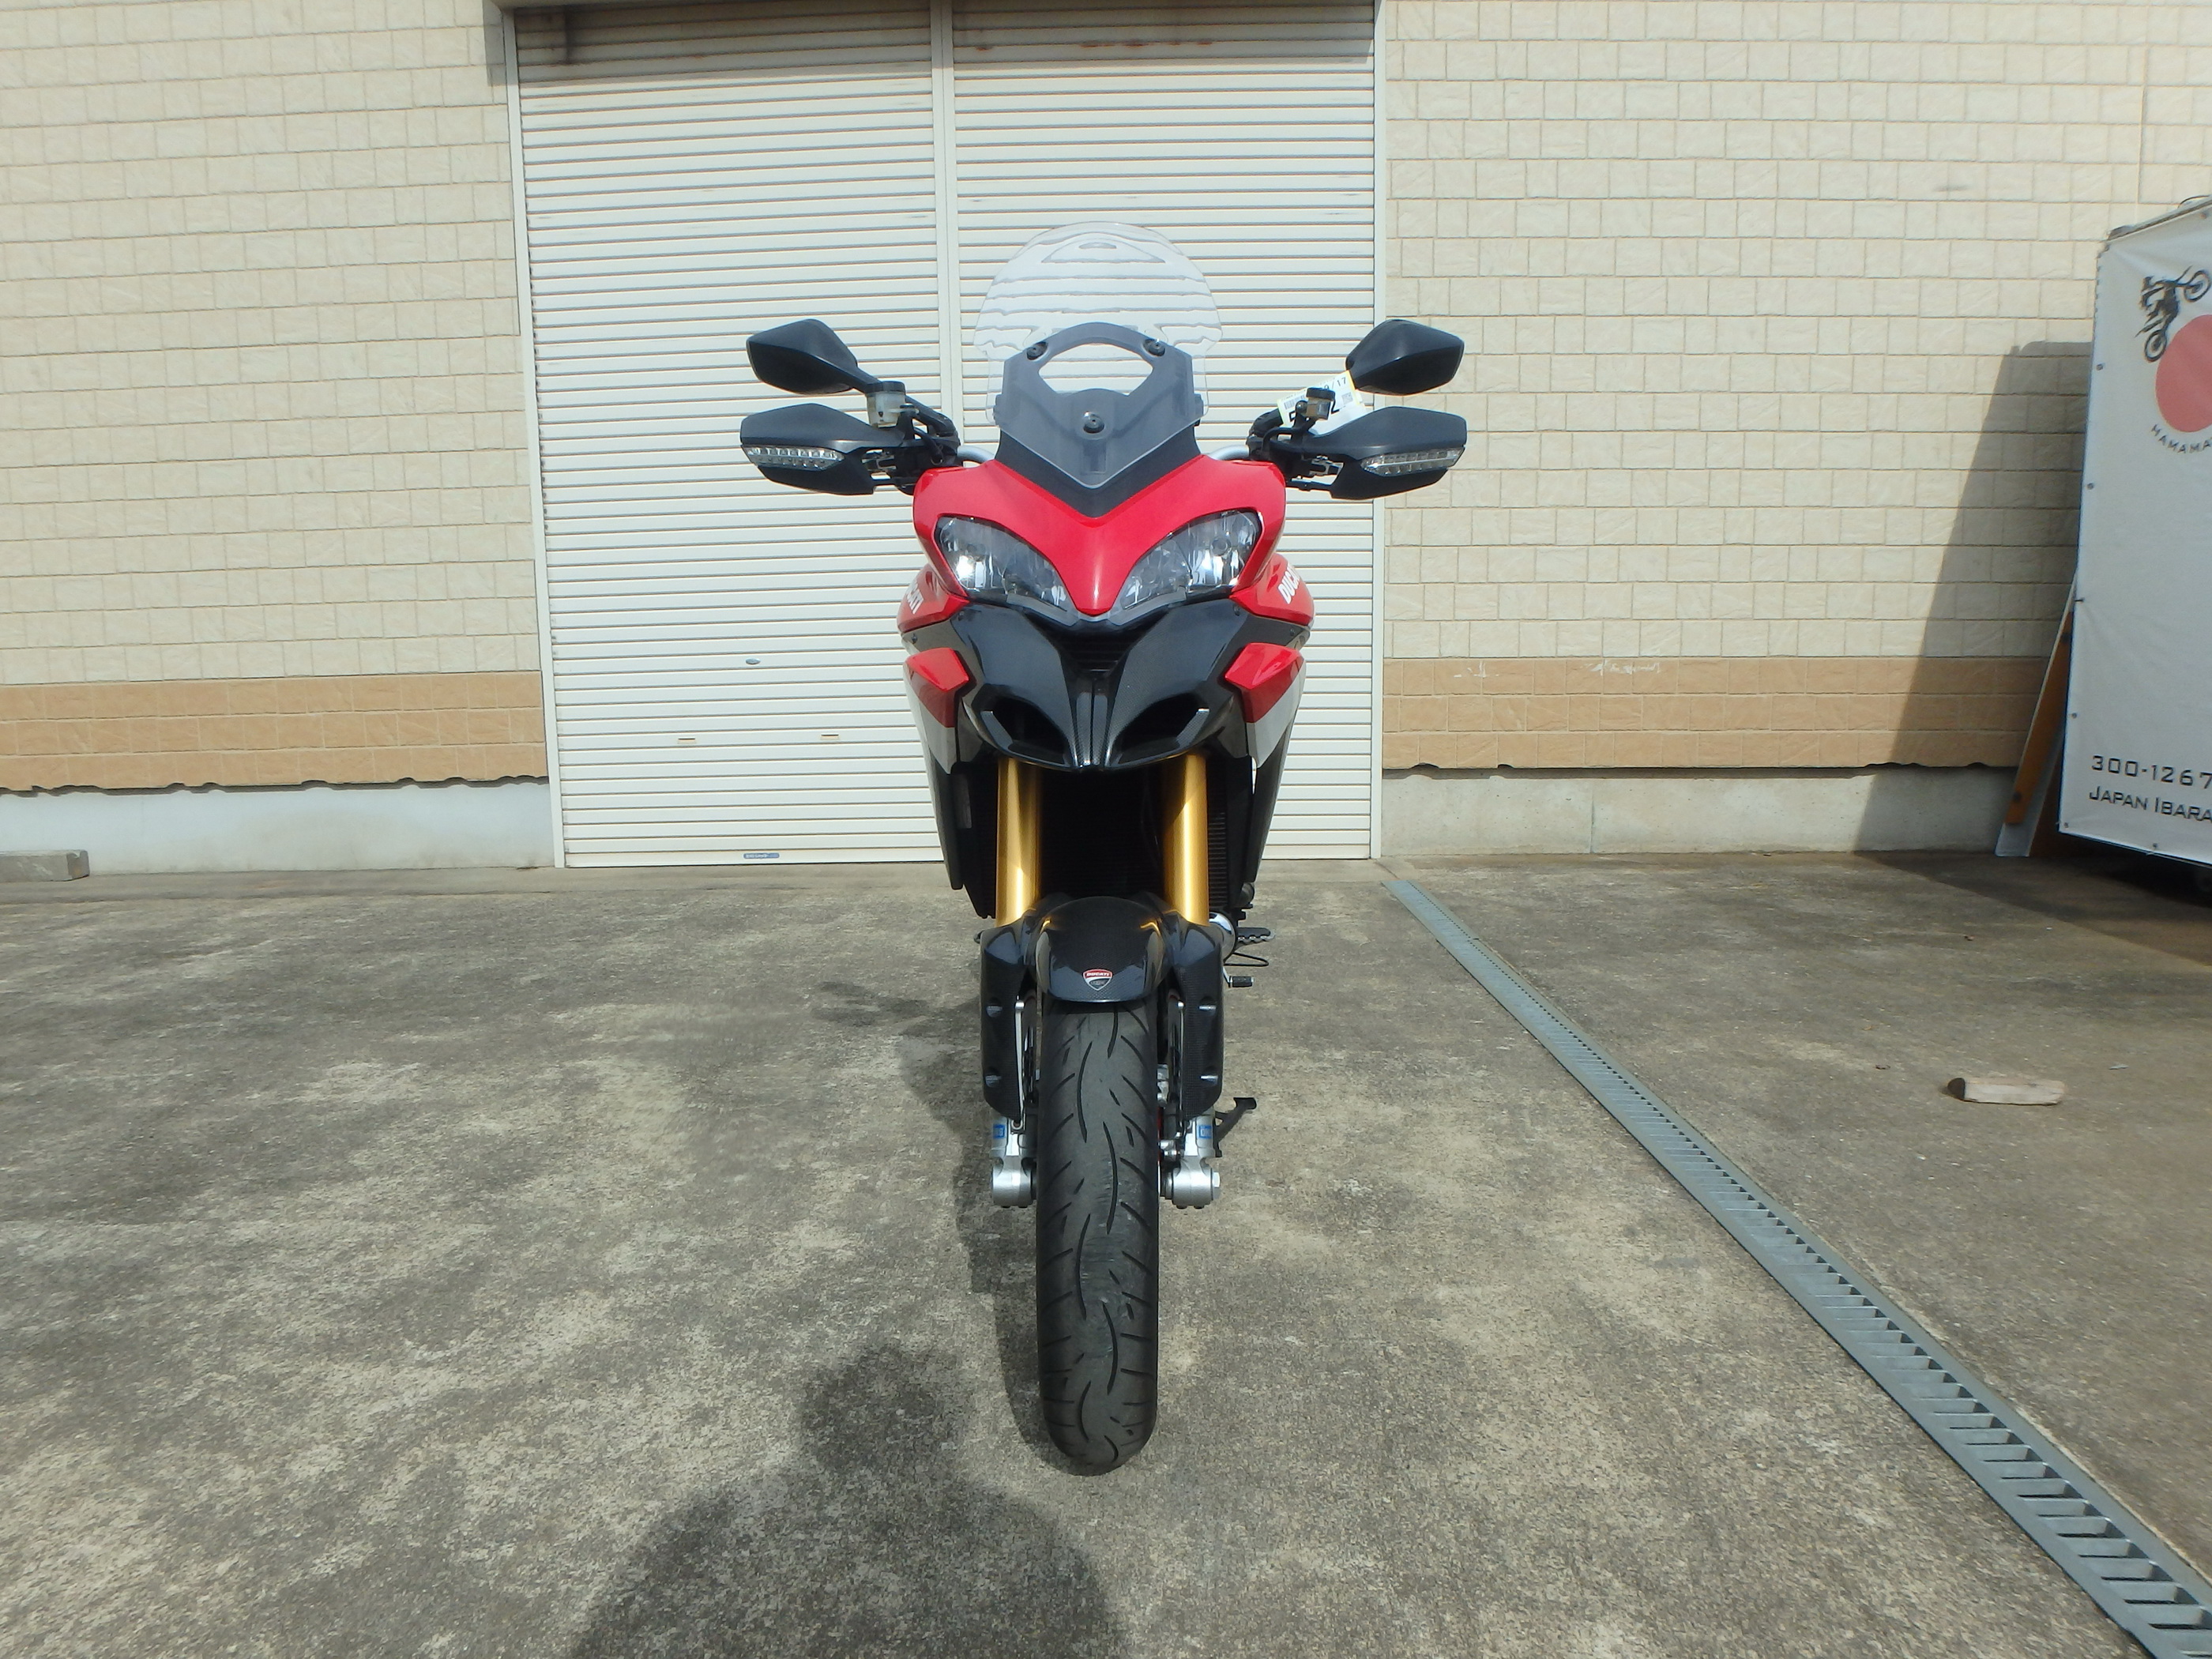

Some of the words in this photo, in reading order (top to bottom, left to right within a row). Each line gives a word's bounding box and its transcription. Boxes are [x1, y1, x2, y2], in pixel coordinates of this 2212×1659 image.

[2150, 423, 2212, 454] HAMAMA
[2091, 754, 2212, 789] 300-1267
[2089, 785, 2149, 811] JAPAN
